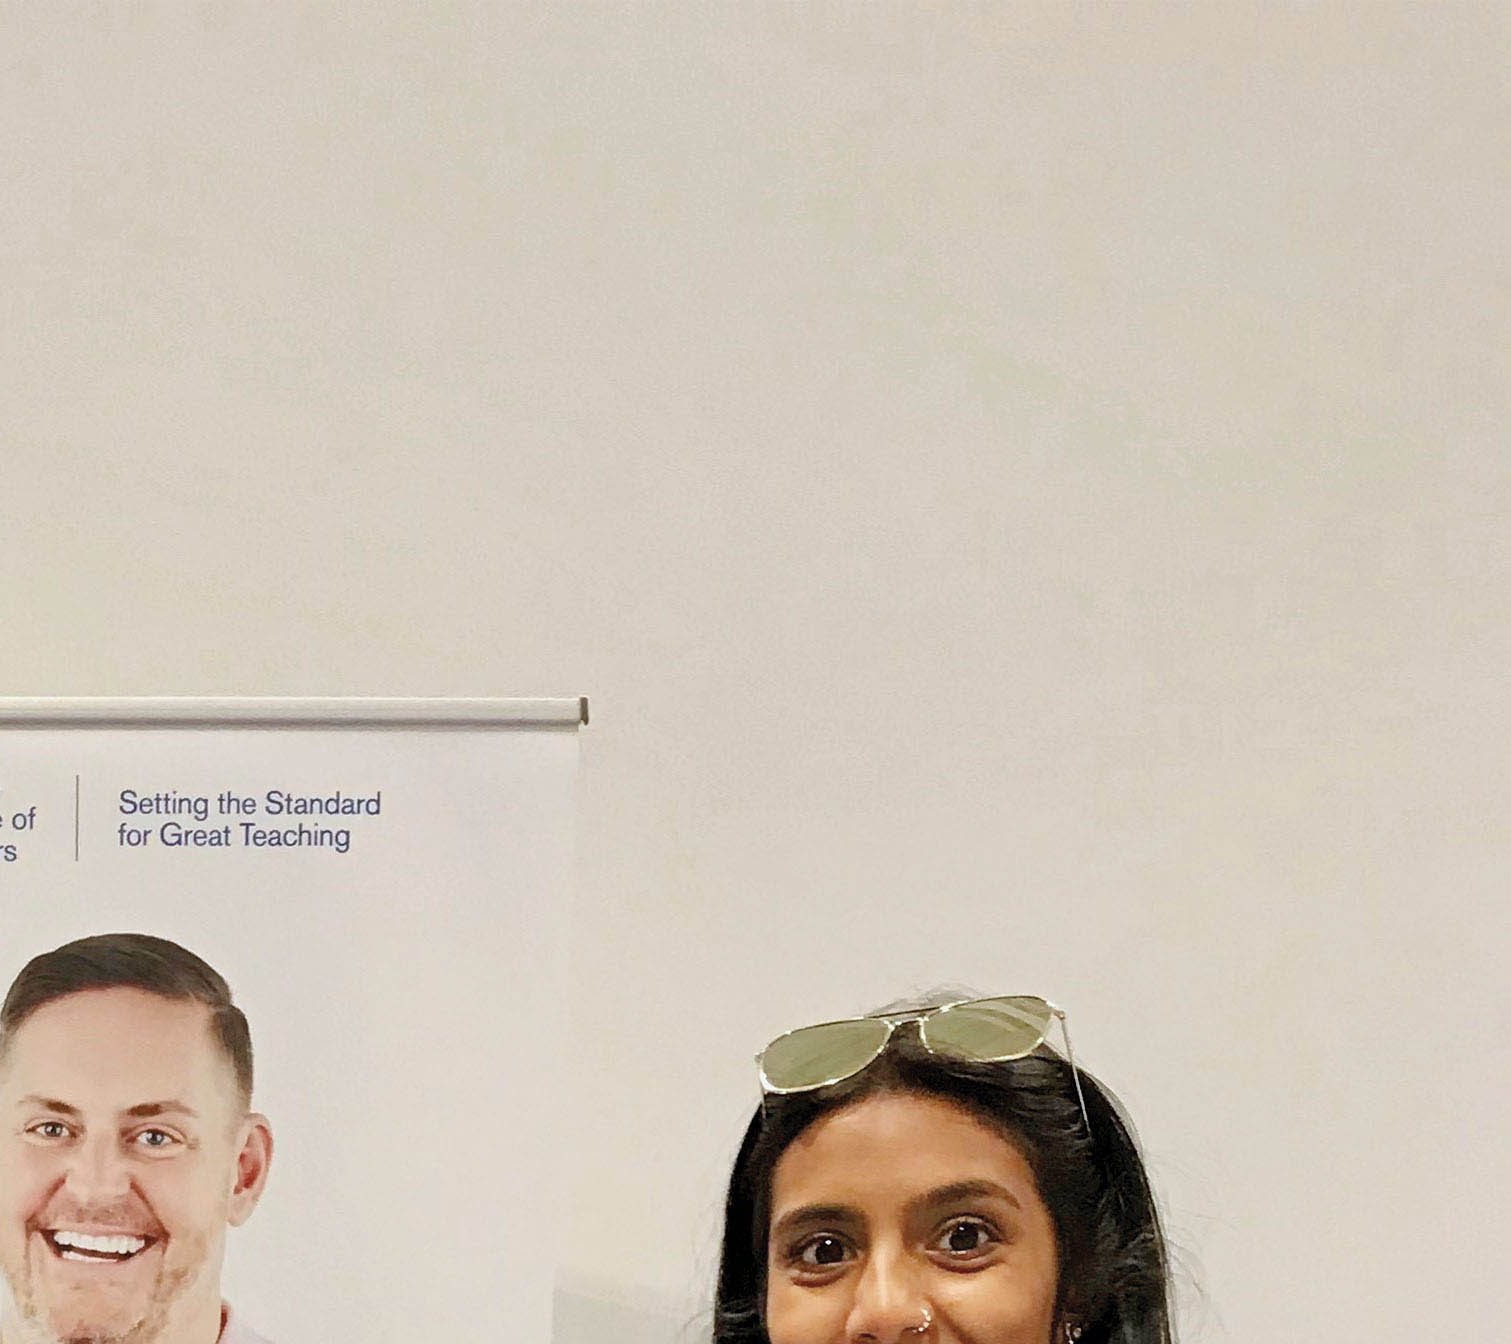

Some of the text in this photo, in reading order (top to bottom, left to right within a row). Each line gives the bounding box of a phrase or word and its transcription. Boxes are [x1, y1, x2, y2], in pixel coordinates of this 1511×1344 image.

[11, 805, 37, 830] of
[118, 789, 381, 819] Setting the Standard
[117, 821, 351, 853] for Great Teaching
